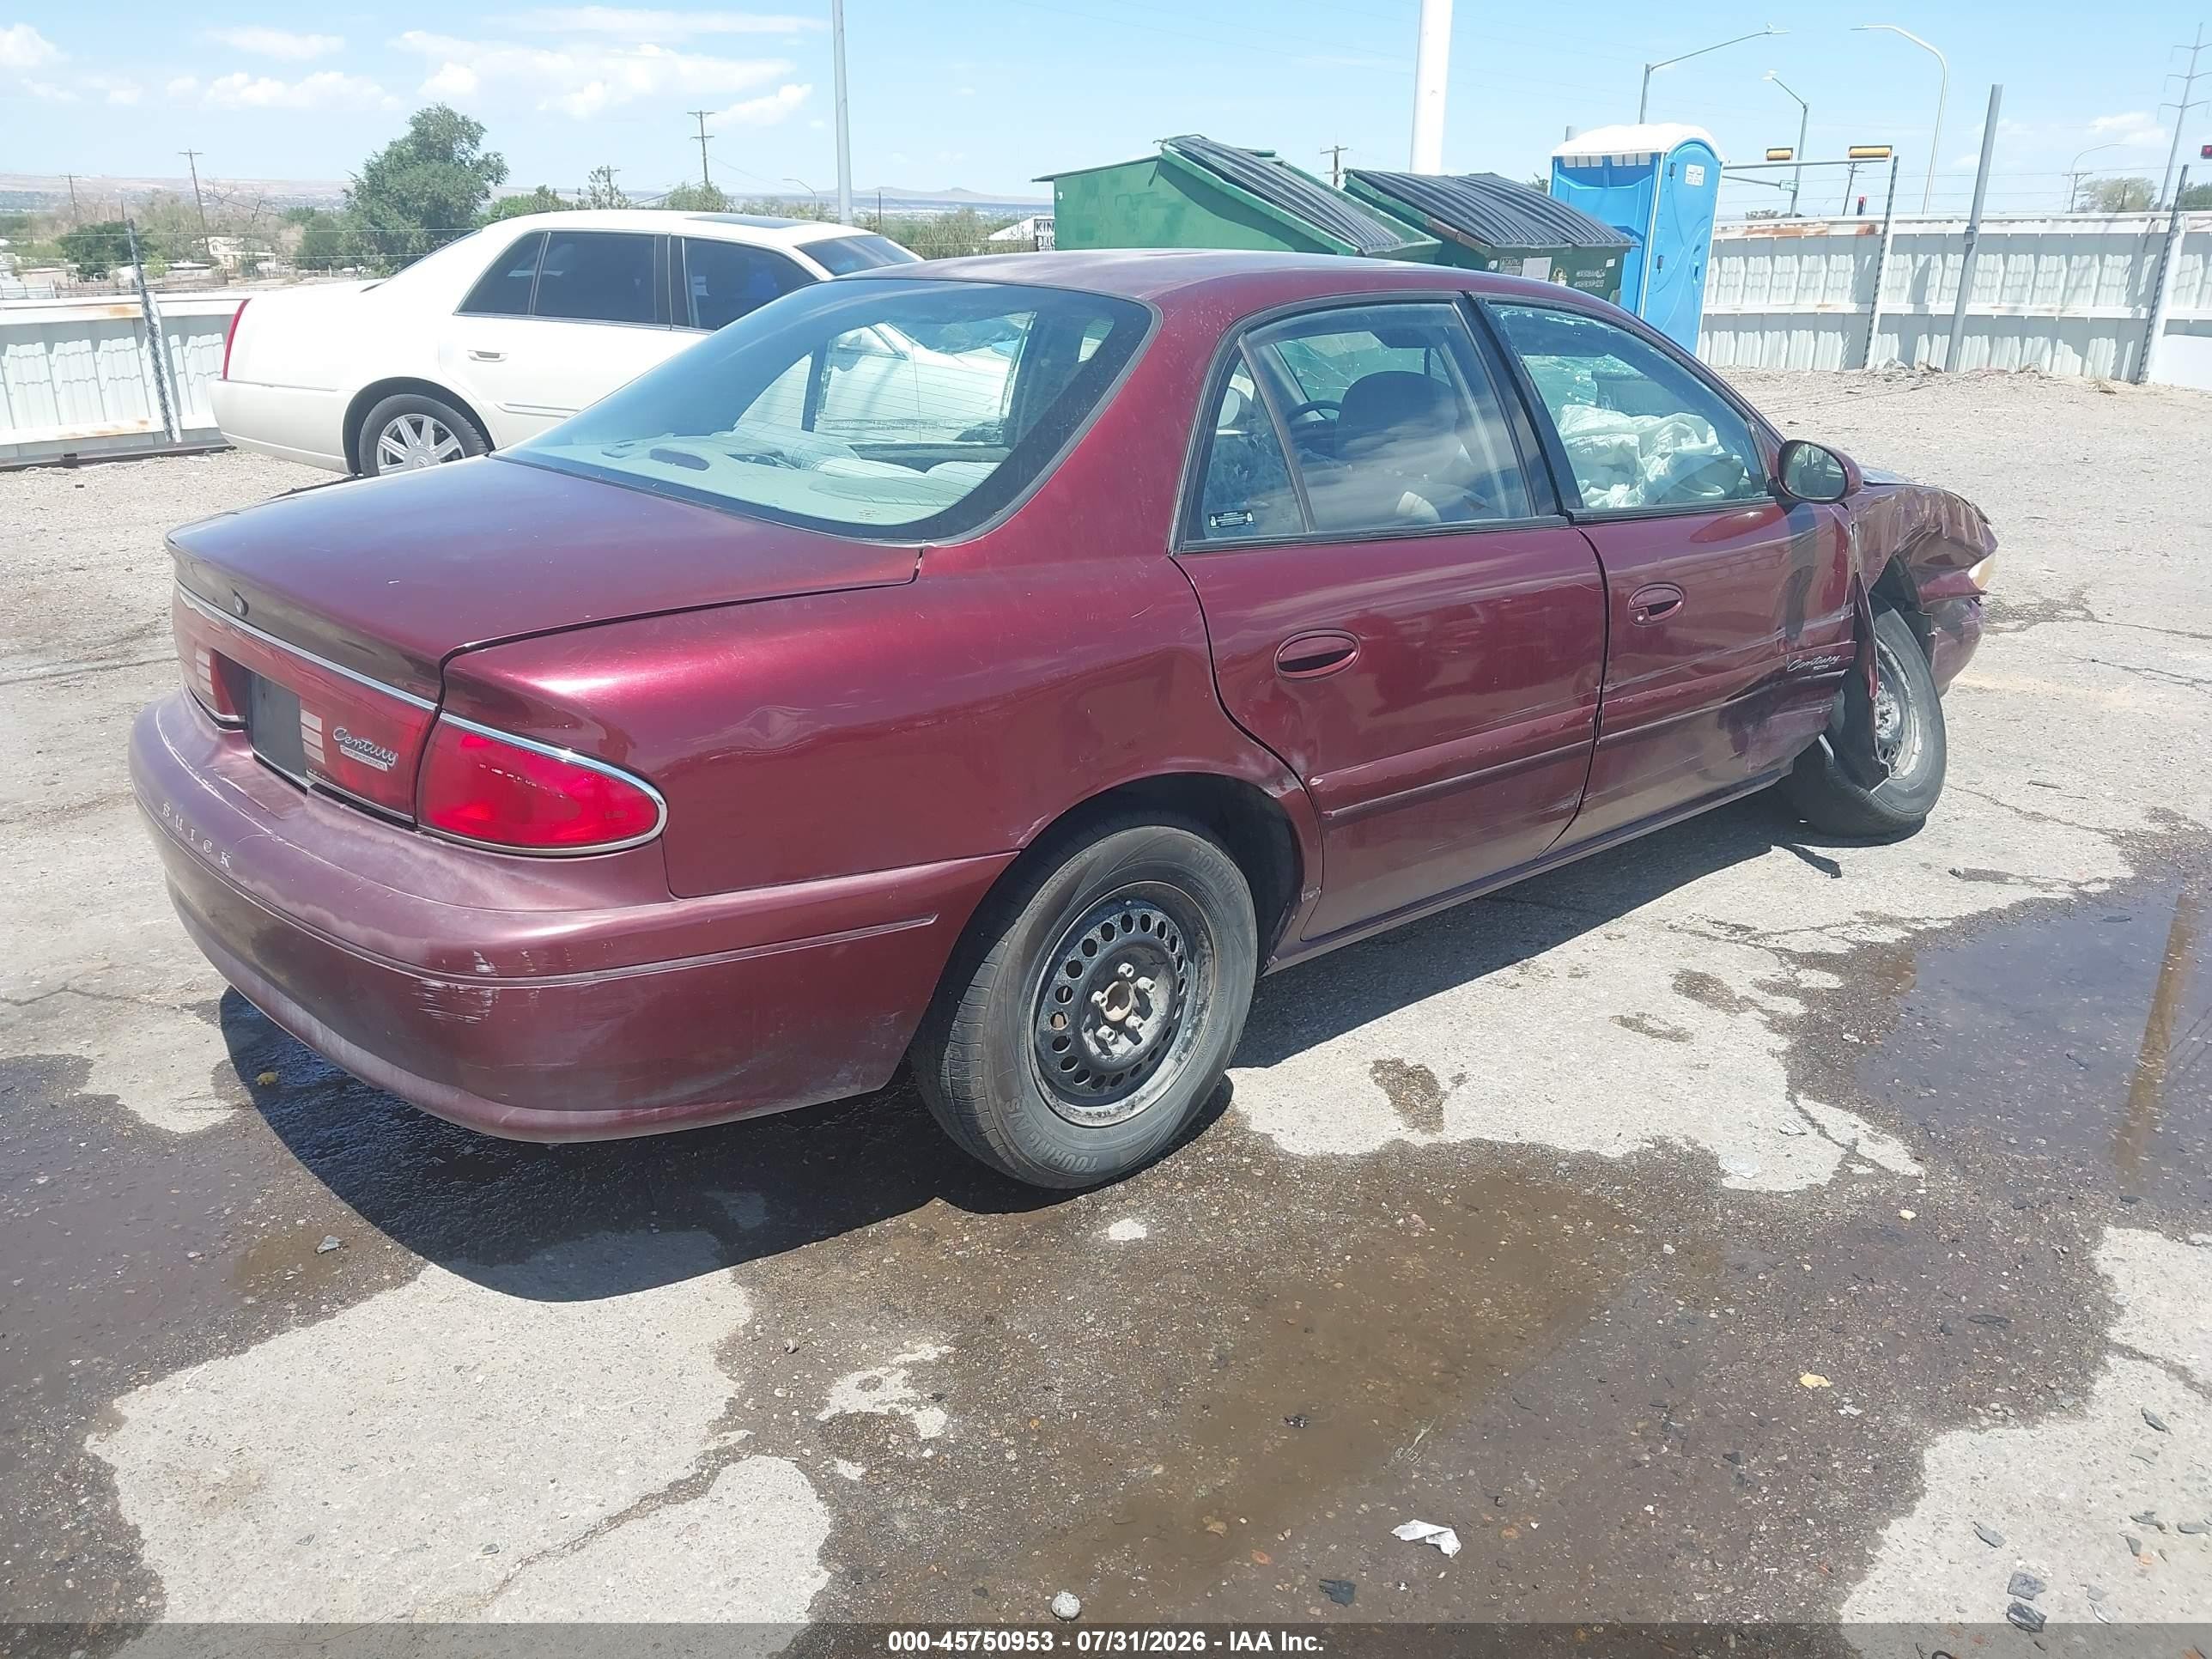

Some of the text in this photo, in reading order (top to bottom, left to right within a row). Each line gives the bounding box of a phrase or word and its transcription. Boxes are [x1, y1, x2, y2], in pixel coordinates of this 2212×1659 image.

[1787, 655, 1841, 672] Century
[333, 726, 399, 767] Century
[162, 802, 232, 869] BUICK
[1030, 1131, 1099, 1172] TOURING
